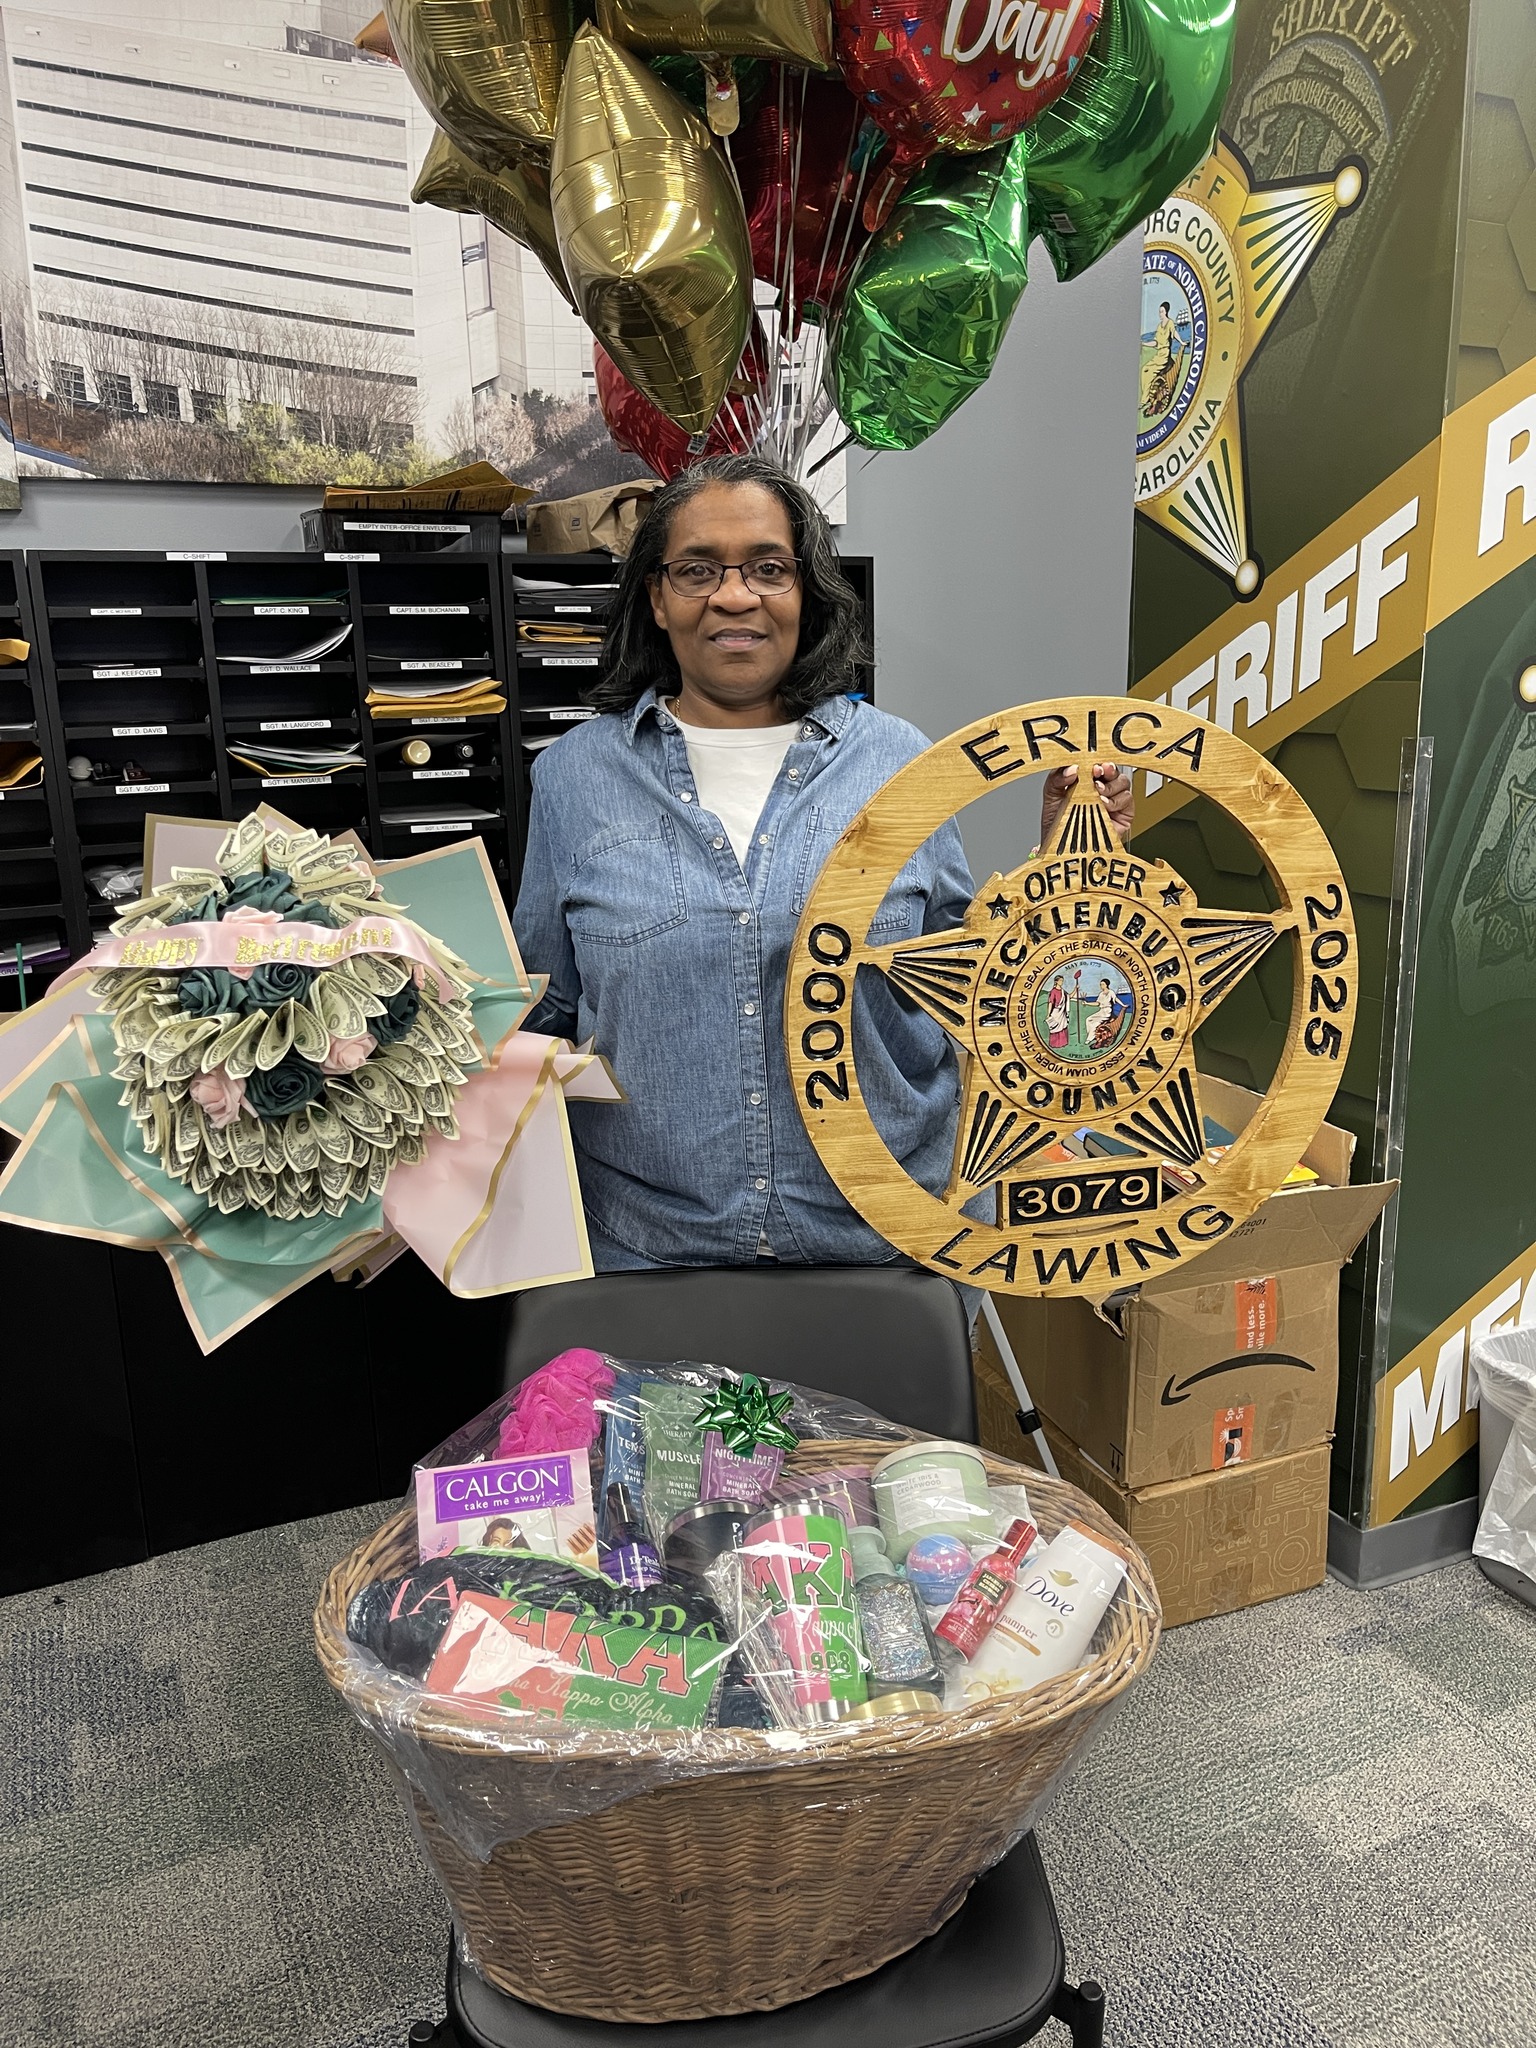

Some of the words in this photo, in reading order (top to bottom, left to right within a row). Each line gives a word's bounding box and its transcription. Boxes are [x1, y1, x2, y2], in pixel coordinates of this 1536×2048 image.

[1184, 216, 1235, 323] COUNTY
[1173, 263, 1204, 318] NORTH
[1169, 320, 1205, 422] CAROLINA
[1133, 399, 1222, 496] AROLINA
[358, 523, 379, 531] EMPTY
[379, 523, 421, 531] INTER-OFFICE
[422, 524, 457, 532] ENVELOPES
[287, 606, 304, 614] KING
[121, 668, 159, 677] KEEFOVER
[282, 664, 312, 672] WALLACE
[289, 721, 325, 729] LANGFORD
[960, 710, 1206, 781] ERICA
[143, 784, 166, 792] SCOTT
[1024, 857, 1146, 903] OFFICER
[1059, 941, 1080, 955] THE
[1082, 940, 1113, 952] STATE
[1113, 947, 1129, 959] OF
[978, 901, 1187, 1027] MECKLENBURG
[1043, 951, 1057, 965] OF
[1024, 965, 1045, 990] SEAL
[1125, 957, 1149, 992] NORTH
[1303, 883, 1348, 1061] 2025
[801, 921, 853, 1110] 2000
[1017, 991, 1029, 1028] GREAT
[1127, 994, 1150, 1046] CAROLINA
[1033, 1053, 1063, 1076] VIDERI
[1065, 1067, 1098, 1077] QUAM
[1098, 1050, 1126, 1072] ESSE
[999, 1046, 1164, 1115] COUNTY
[1016, 1174, 1152, 1219] 3079
[932, 1203, 1235, 1285] LAWING
[1246, 1306, 1255, 1329] less.
[1258, 1299, 1266, 1330] more.
[715, 1448, 774, 1467] NIGHIME
[666, 1487, 681, 1496] BATH
[682, 1489, 698, 1499] SOAK
[668, 1480, 696, 1491] MINERAL
[722, 1486, 740, 1495] BATH
[896, 1479, 942, 1496] CEDARWOOD
[464, 1500, 489, 1512] take
[493, 1498, 510, 1508] me
[514, 1491, 546, 1506] away!
[1025, 1576, 1075, 1617] Dove
[536, 1671, 605, 1710] Kappa
[608, 1691, 674, 1724] Alpha
